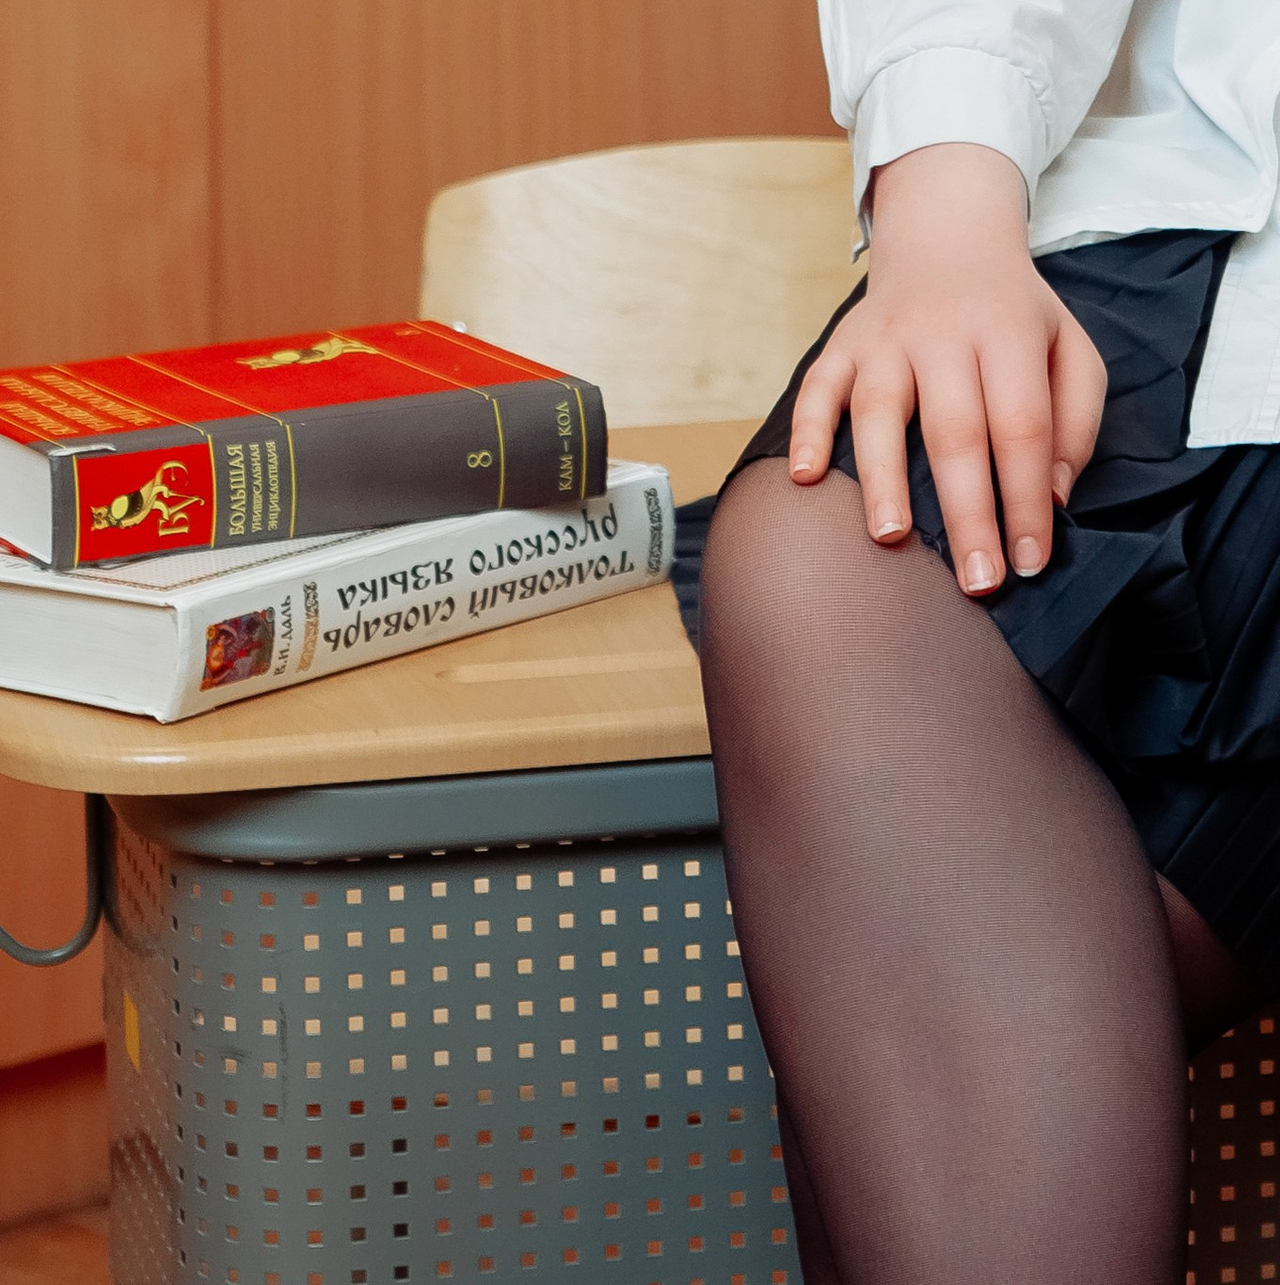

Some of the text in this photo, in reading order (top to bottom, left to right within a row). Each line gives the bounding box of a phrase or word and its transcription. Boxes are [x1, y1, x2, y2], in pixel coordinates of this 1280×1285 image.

[555, 401, 572, 437] КОЛ
[229, 443, 245, 536] БОЛЬШАЯ
[249, 443, 261, 533] УНИВЕРСАЛЬНАЯ
[267, 440, 279, 531] ЭНЦИКЛОПЕДИЯ
[467, 449, 494, 469] 8
[558, 456, 574, 492] КАМ
